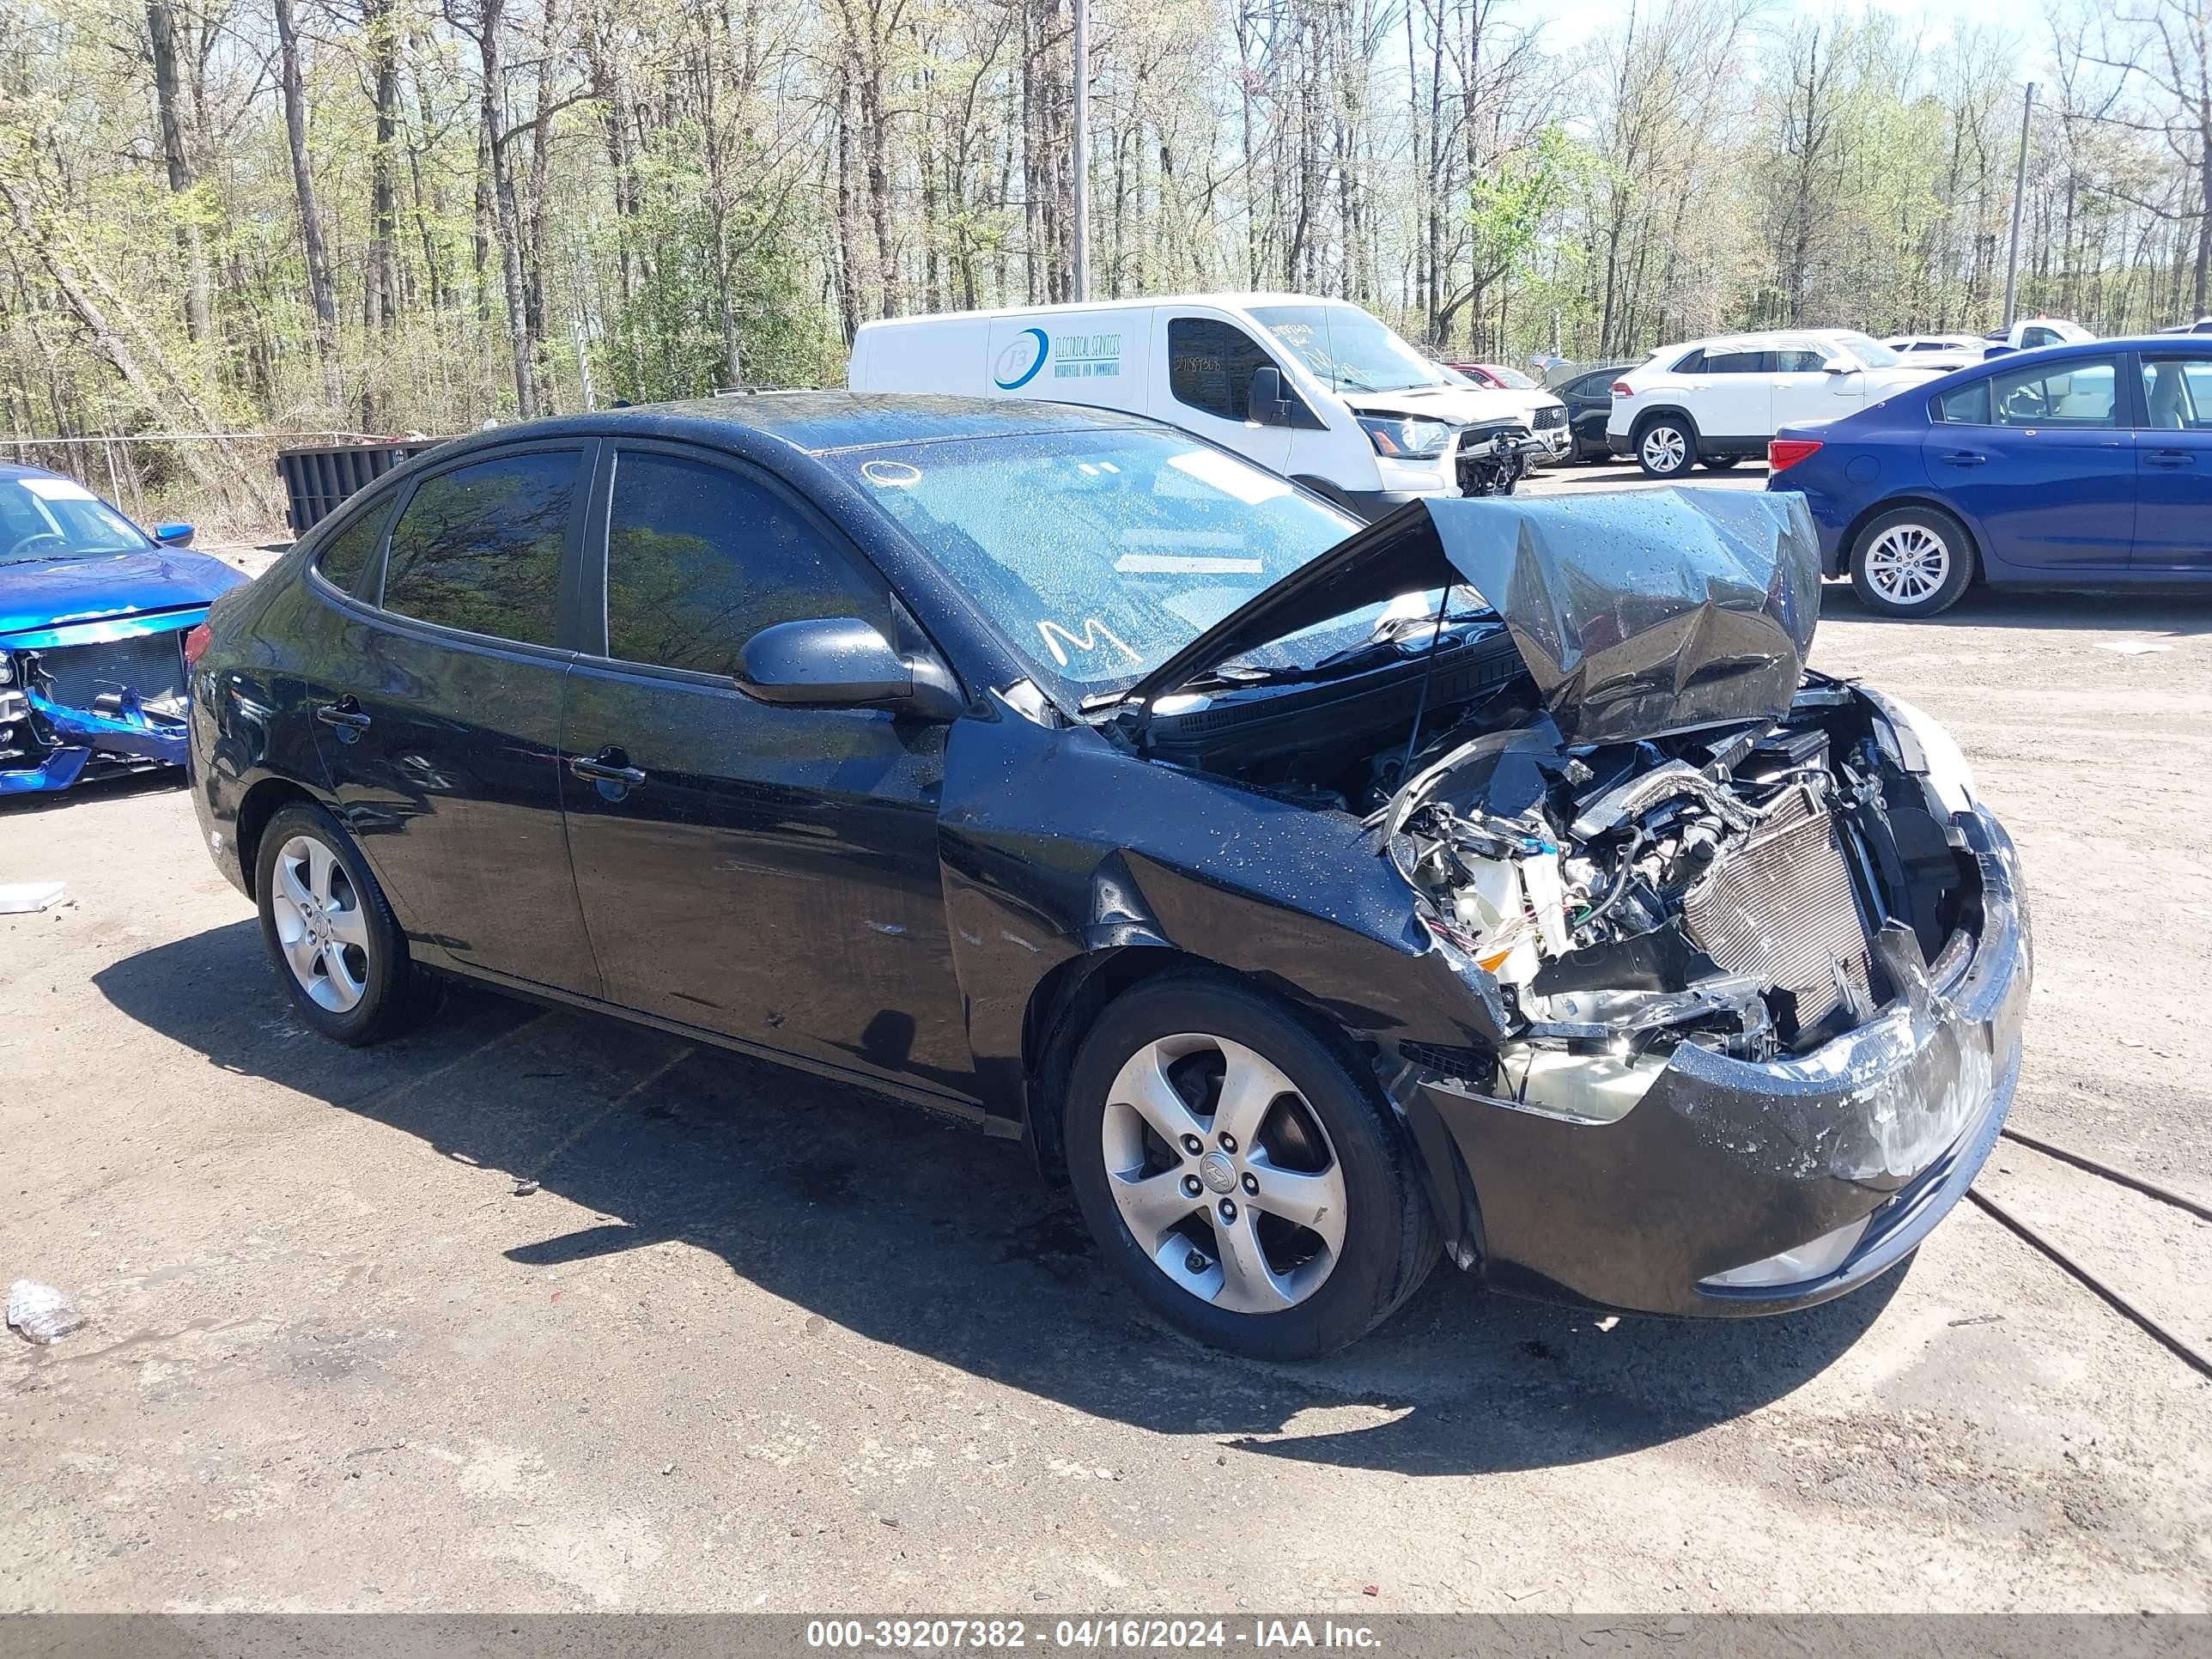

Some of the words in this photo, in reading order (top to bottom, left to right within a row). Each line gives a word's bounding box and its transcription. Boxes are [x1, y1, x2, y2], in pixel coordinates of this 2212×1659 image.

[1055, 336, 1090, 358] ELECTRICAL
[1091, 333, 1121, 356] SERVICES
[1005, 349, 1029, 373] J3
[1054, 363, 1081, 379] RESIDENTIAL
[1083, 363, 1091, 378] AND
[1093, 362, 1120, 377] COMMERCIAL
[1036, 618, 1144, 667] M
